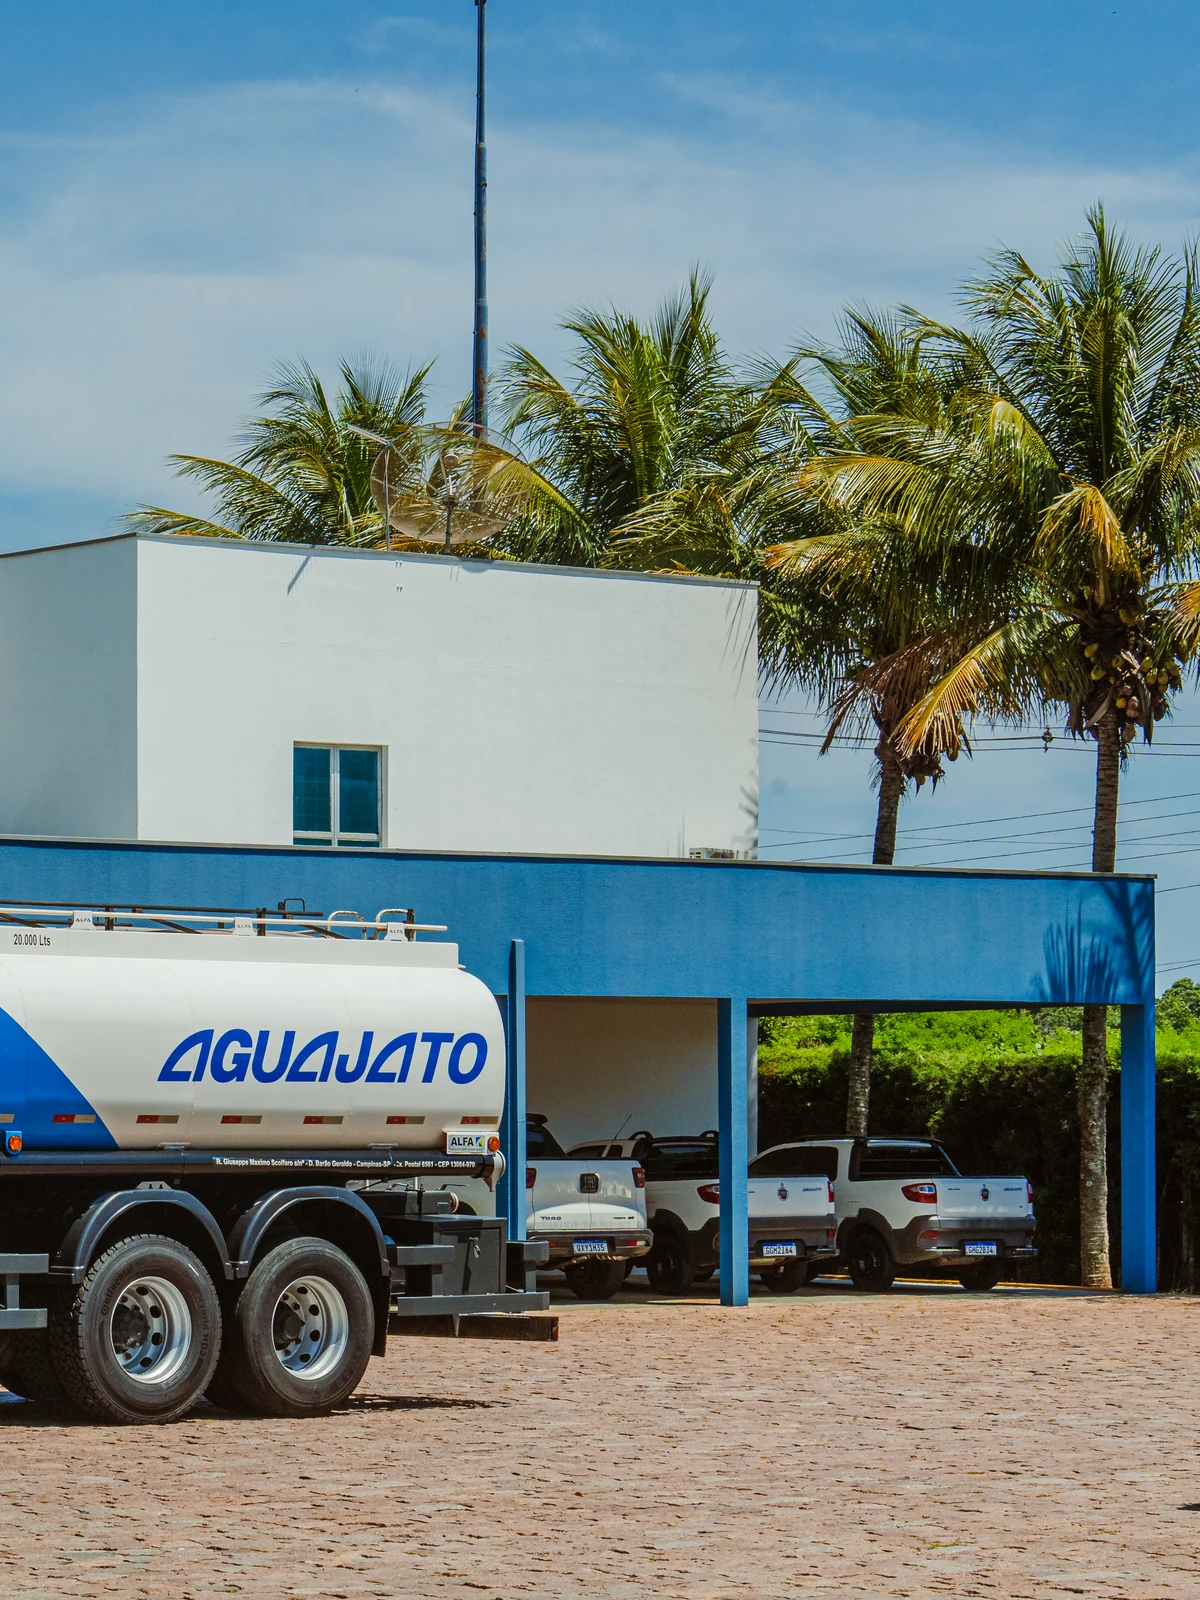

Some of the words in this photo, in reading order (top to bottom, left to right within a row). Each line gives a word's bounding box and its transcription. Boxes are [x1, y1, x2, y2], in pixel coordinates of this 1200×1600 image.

[13, 933, 38, 946] 20.000
[39, 934, 51, 947] Lts
[157, 1028, 489, 1085] AGUAJATO
[450, 1136, 474, 1146] ALFA
[404, 1160, 421, 1168] Postal
